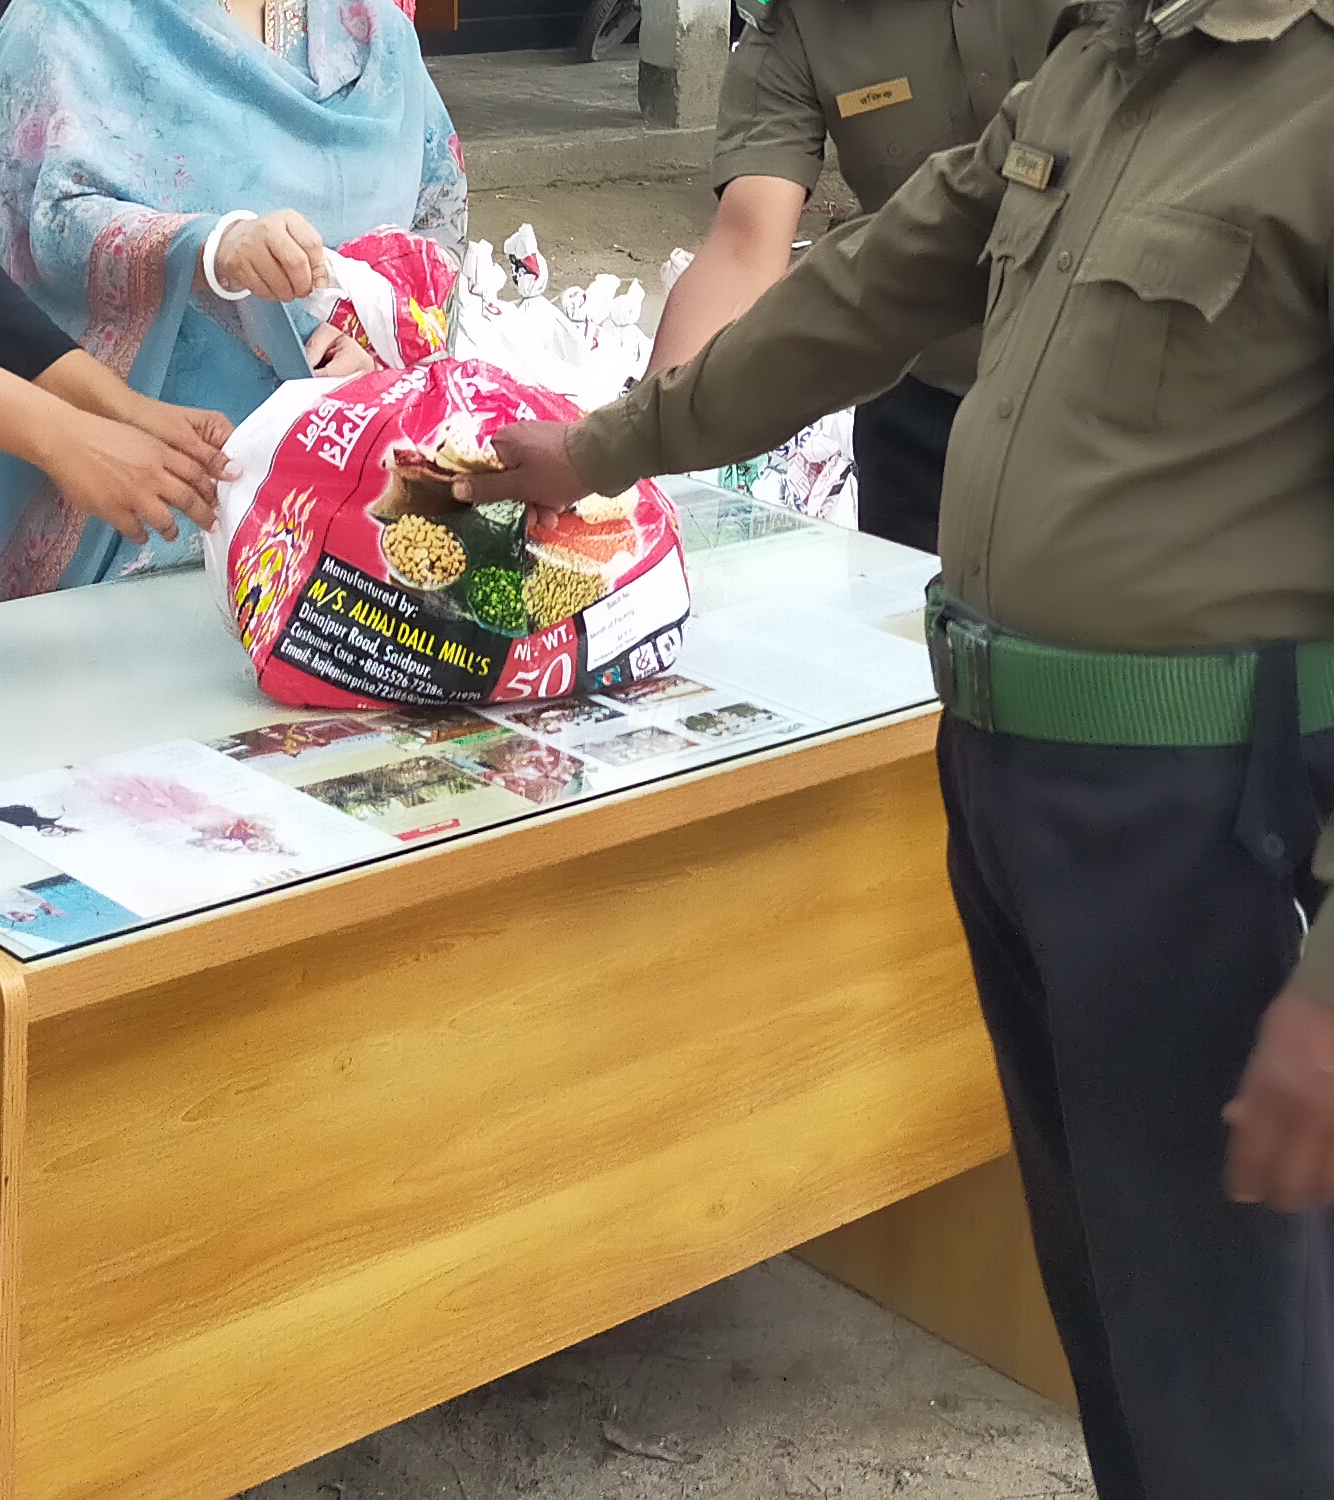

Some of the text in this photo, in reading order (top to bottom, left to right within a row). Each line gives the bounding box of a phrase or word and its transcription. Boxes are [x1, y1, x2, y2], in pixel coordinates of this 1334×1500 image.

[321, 556, 419, 618] Manufactured by:
[280, 637, 312, 663] Email:
[290, 622, 332, 653] Customer
[333, 643, 357, 666] Care:
[299, 602, 432, 680] Dinajpur Road, Saidpur.
[308, 579, 491, 678] M/S. ALHAJ DALL MILL'S
[542, 624, 574, 651] WT.
[506, 652, 572, 698] 50
